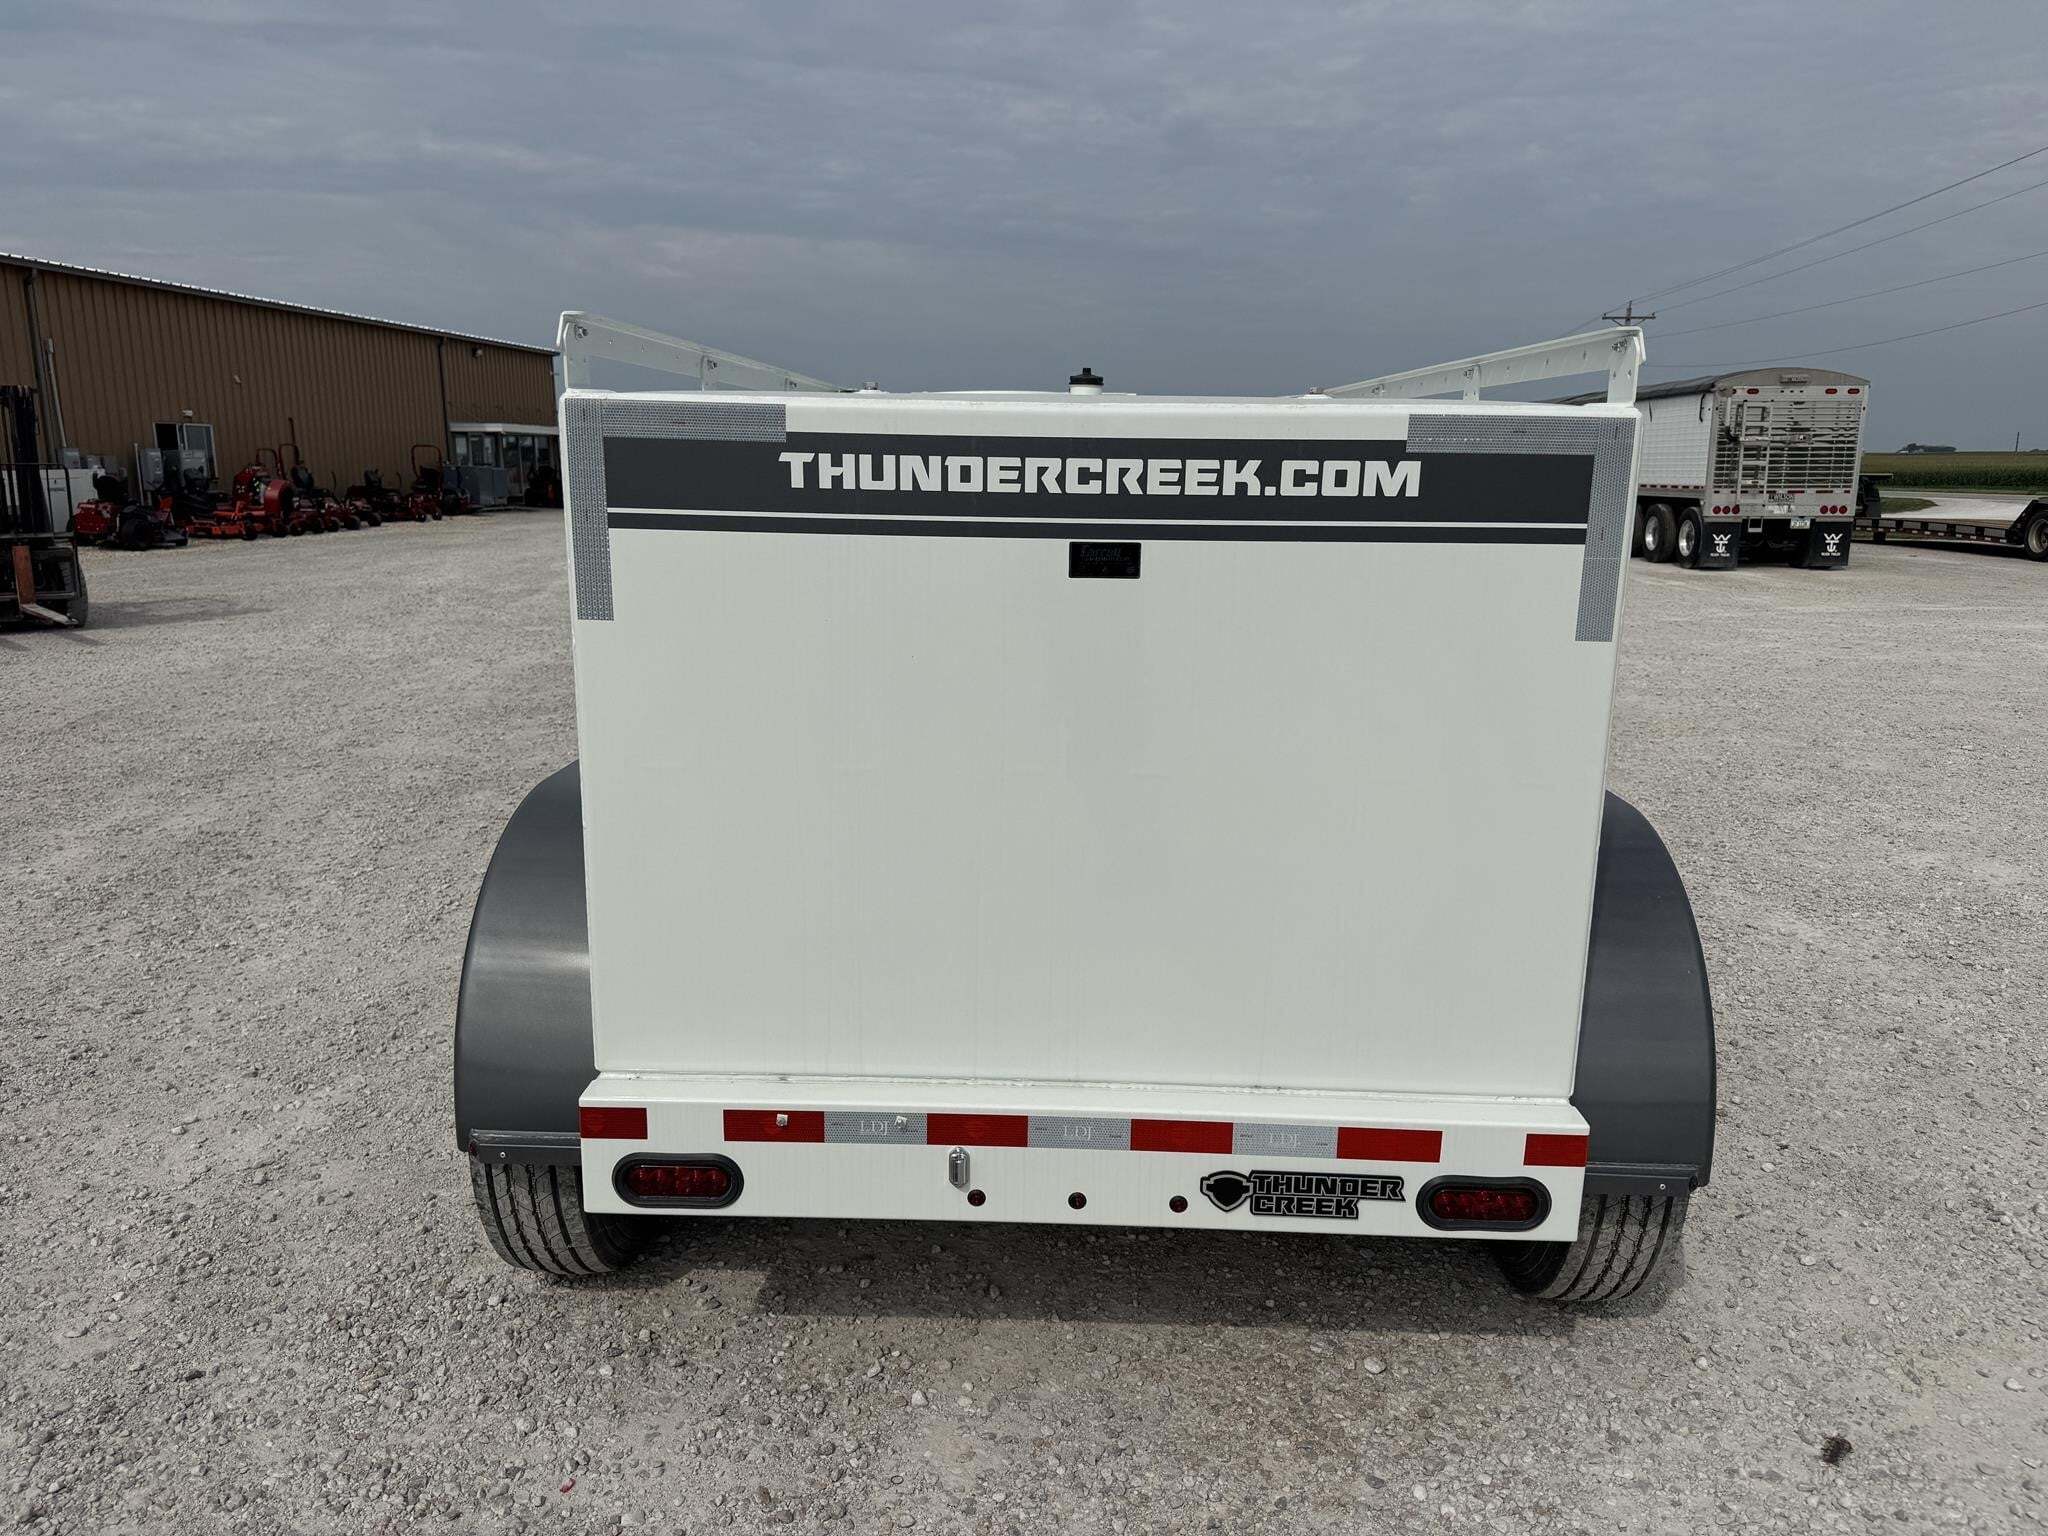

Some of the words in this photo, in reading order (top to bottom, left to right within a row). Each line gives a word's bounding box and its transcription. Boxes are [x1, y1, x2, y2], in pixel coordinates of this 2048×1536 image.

[778, 451, 1422, 498] THUNDERCREEK.COM
[1251, 1173, 1404, 1200] THUNDER
[1252, 1194, 1359, 1218] CREEK
